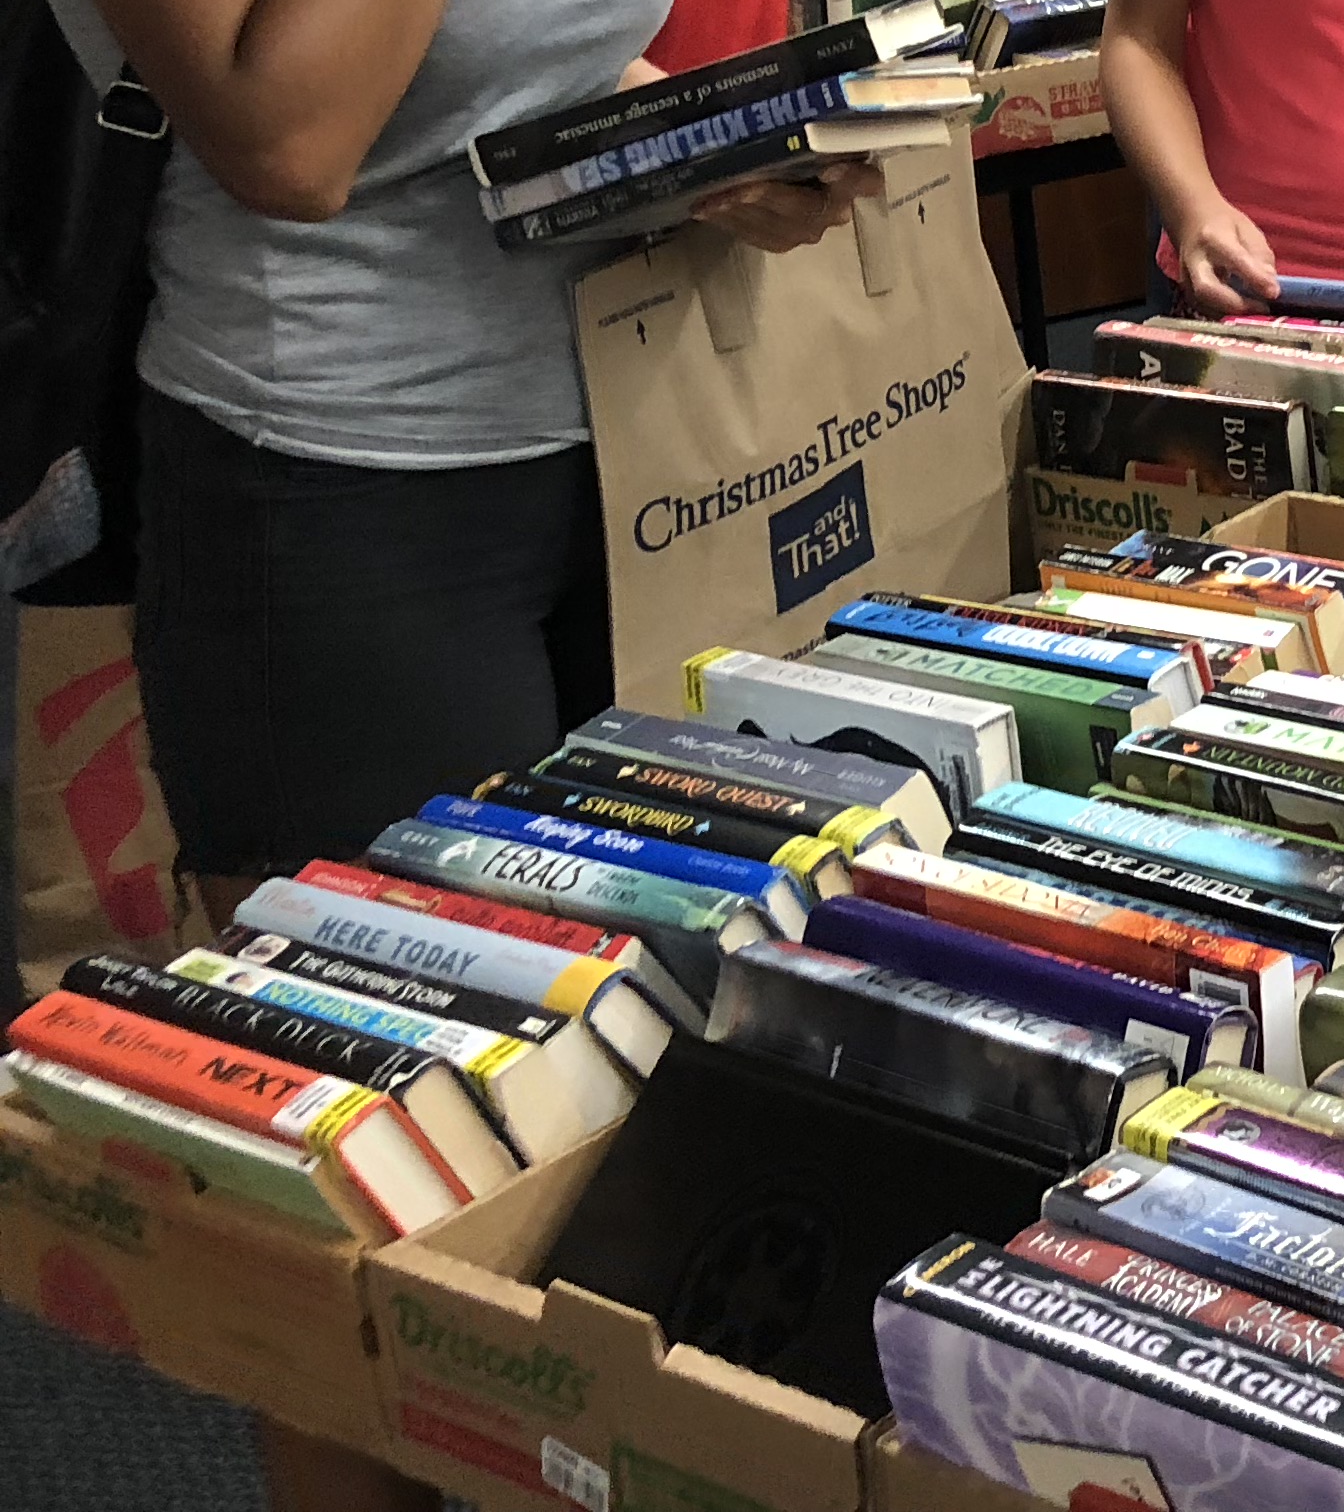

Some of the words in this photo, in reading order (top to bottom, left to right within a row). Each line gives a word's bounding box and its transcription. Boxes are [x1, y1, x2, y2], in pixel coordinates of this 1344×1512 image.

[683, 90, 693, 102] a
[696, 82, 712, 106] of
[714, 61, 780, 91] memoirs
[553, 112, 622, 145] amnesiac
[624, 91, 680, 122] teenage
[750, 86, 812, 128] THE
[624, 108, 746, 174] KILLING
[560, 152, 622, 193] SEA
[1222, 415, 1248, 483] BAD
[632, 441, 820, 554] Christmas
[816, 402, 883, 468] Tree
[812, 494, 850, 536] and
[777, 498, 863, 582] That!
[908, 651, 1095, 694] MATCHED
[634, 766, 717, 799] SWORD
[717, 783, 797, 815] QUEST
[481, 842, 589, 893] FERALS
[1036, 834, 1089, 863] THE
[1089, 845, 1134, 873] EYE
[1135, 859, 1167, 883] OF
[312, 914, 387, 956] HERE
[389, 934, 480, 977] TODAY
[173, 985, 276, 1033] BLACK
[263, 979, 376, 1027] NOTHING
[199, 1055, 302, 1102] NEXT
[1027, 1232, 1098, 1268] HALE
[984, 1273, 1174, 1362] LIGHTNING
[1176, 1345, 1344, 1424] CATCHER
[1225, 1314, 1252, 1337] OF
